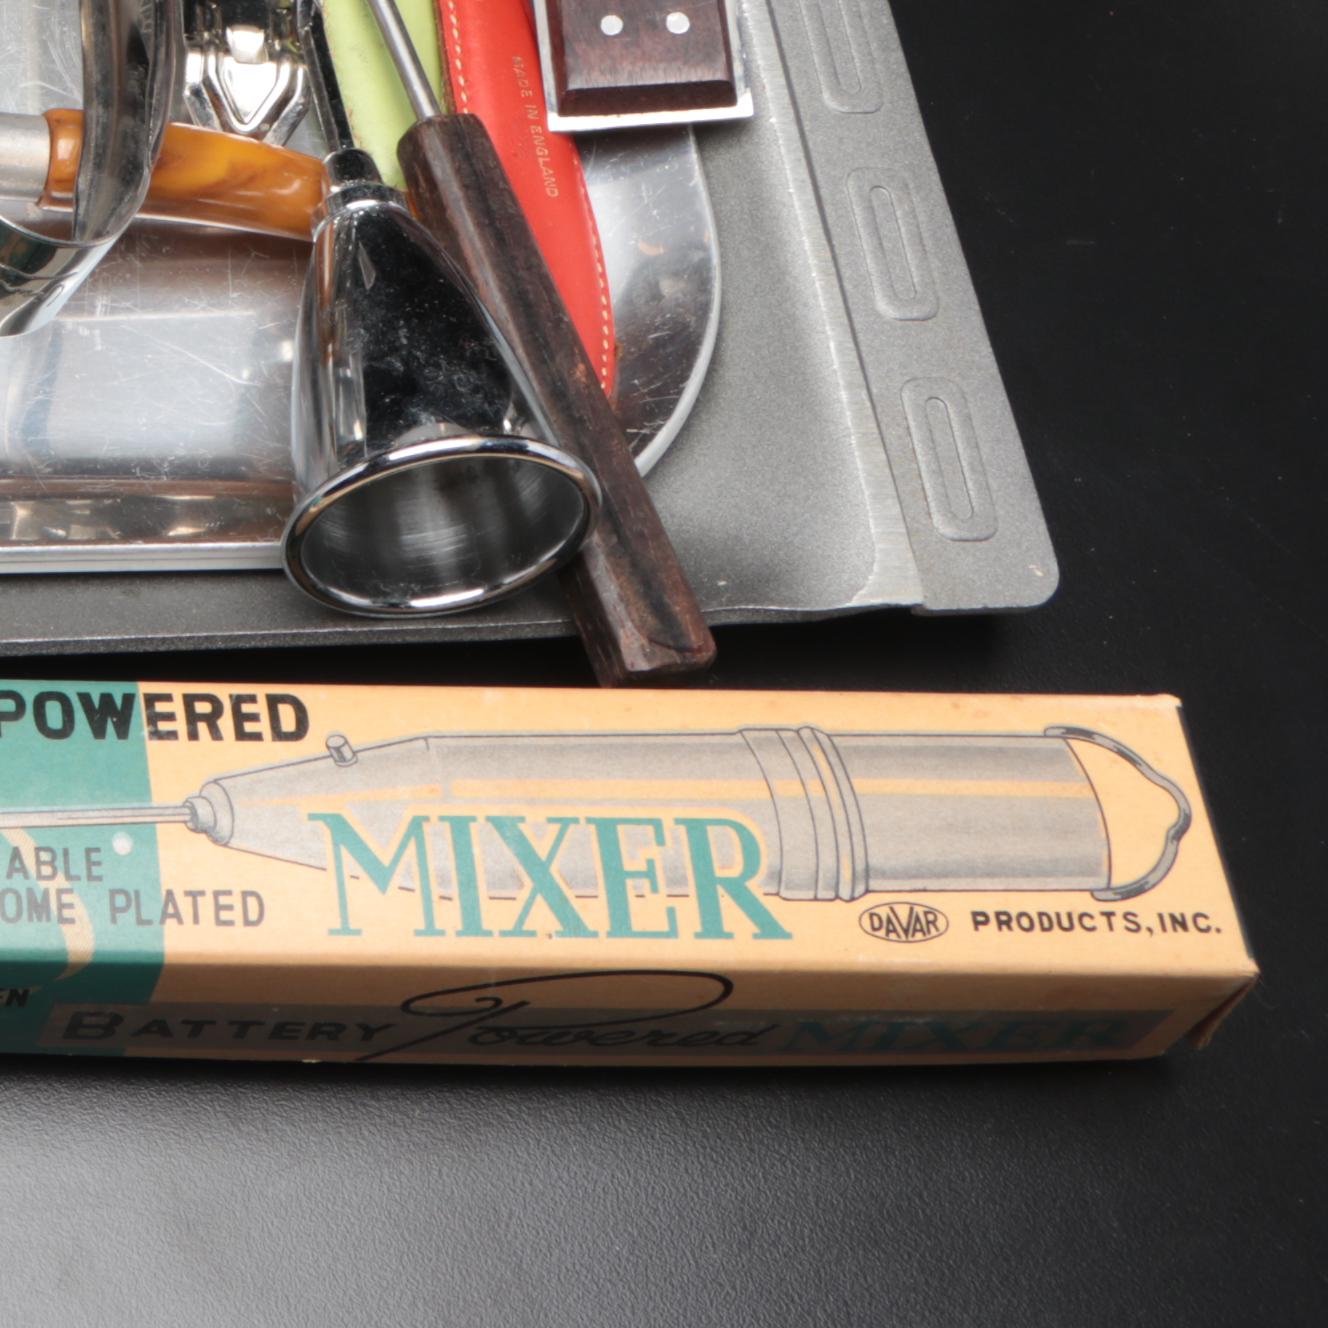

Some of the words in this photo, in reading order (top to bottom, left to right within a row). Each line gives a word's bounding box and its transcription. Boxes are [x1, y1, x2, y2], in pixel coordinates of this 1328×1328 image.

[512, 55, 532, 99] MADE
[525, 103, 537, 121] IN
[530, 125, 559, 199] ENGLAND
[306, 812, 792, 940] MIXER
[107, 889, 265, 927] PLATED
[868, 909, 939, 938] DAVAR
[62, 1008, 400, 1045] BATTERY
[784, 1017, 1134, 1052] MIXER
